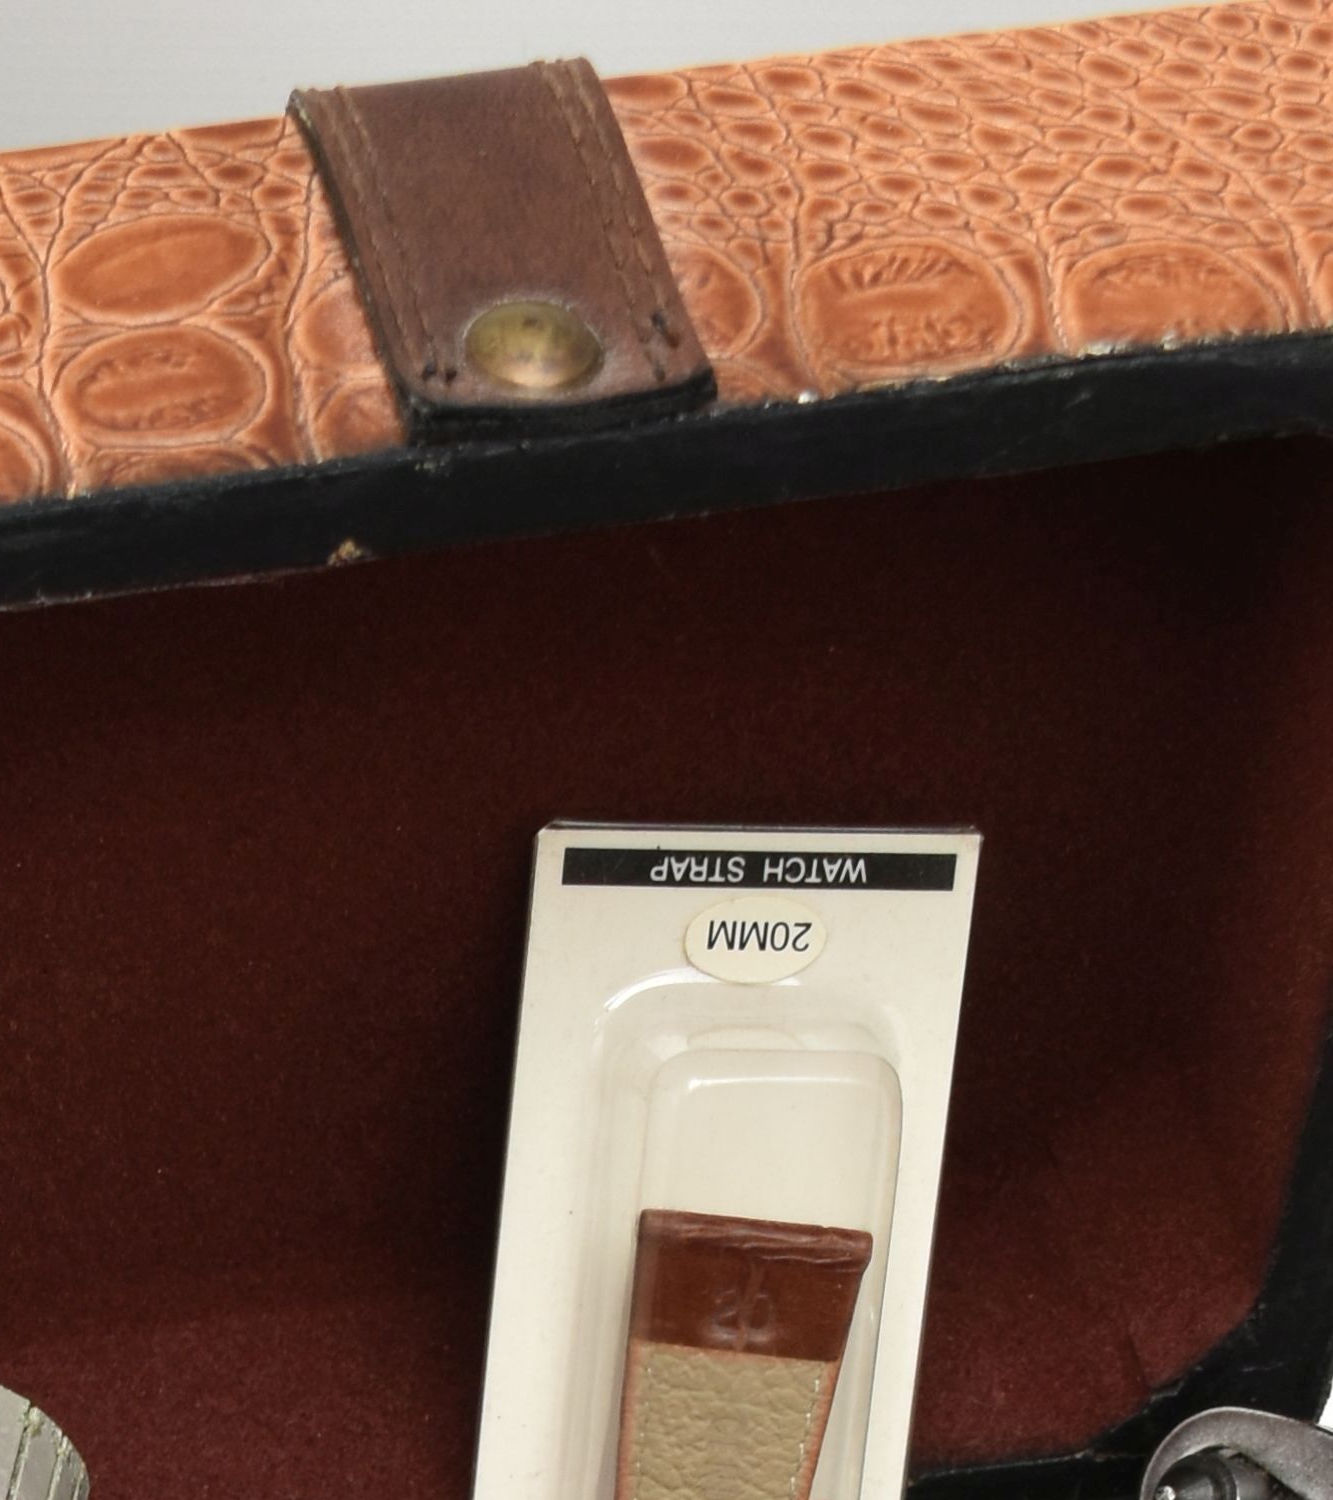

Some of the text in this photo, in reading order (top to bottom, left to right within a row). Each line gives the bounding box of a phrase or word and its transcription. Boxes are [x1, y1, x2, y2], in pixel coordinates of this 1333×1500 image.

[651, 856, 867, 884] WATCH STRAP
[707, 921, 812, 952] 20MM
